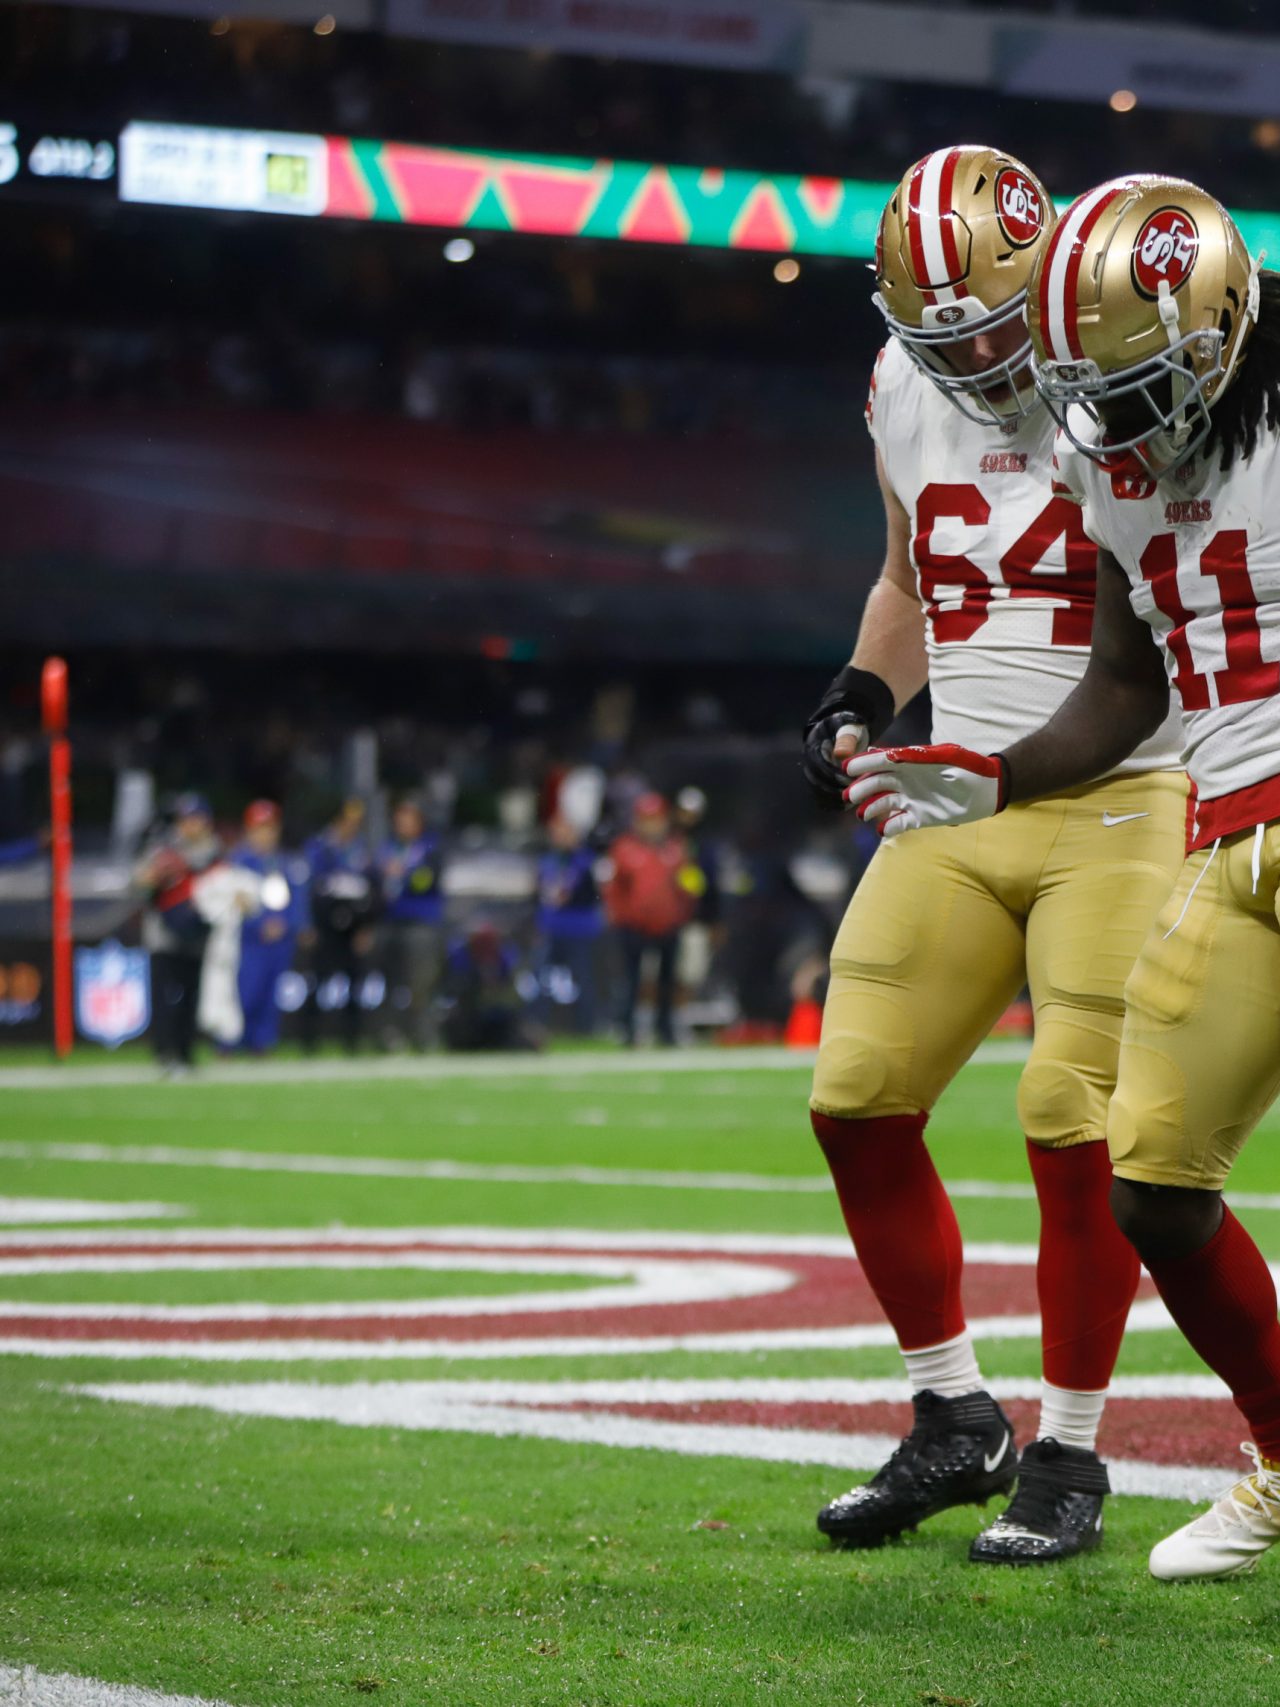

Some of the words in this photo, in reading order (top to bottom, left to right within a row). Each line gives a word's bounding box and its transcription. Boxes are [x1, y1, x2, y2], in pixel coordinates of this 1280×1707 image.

[1002, 178, 1041, 224] SF
[1140, 219, 1194, 275] SF
[979, 453, 1028, 473] 49ERS
[1164, 499, 1212, 524] 49ERS
[913, 483, 1099, 646] 64
